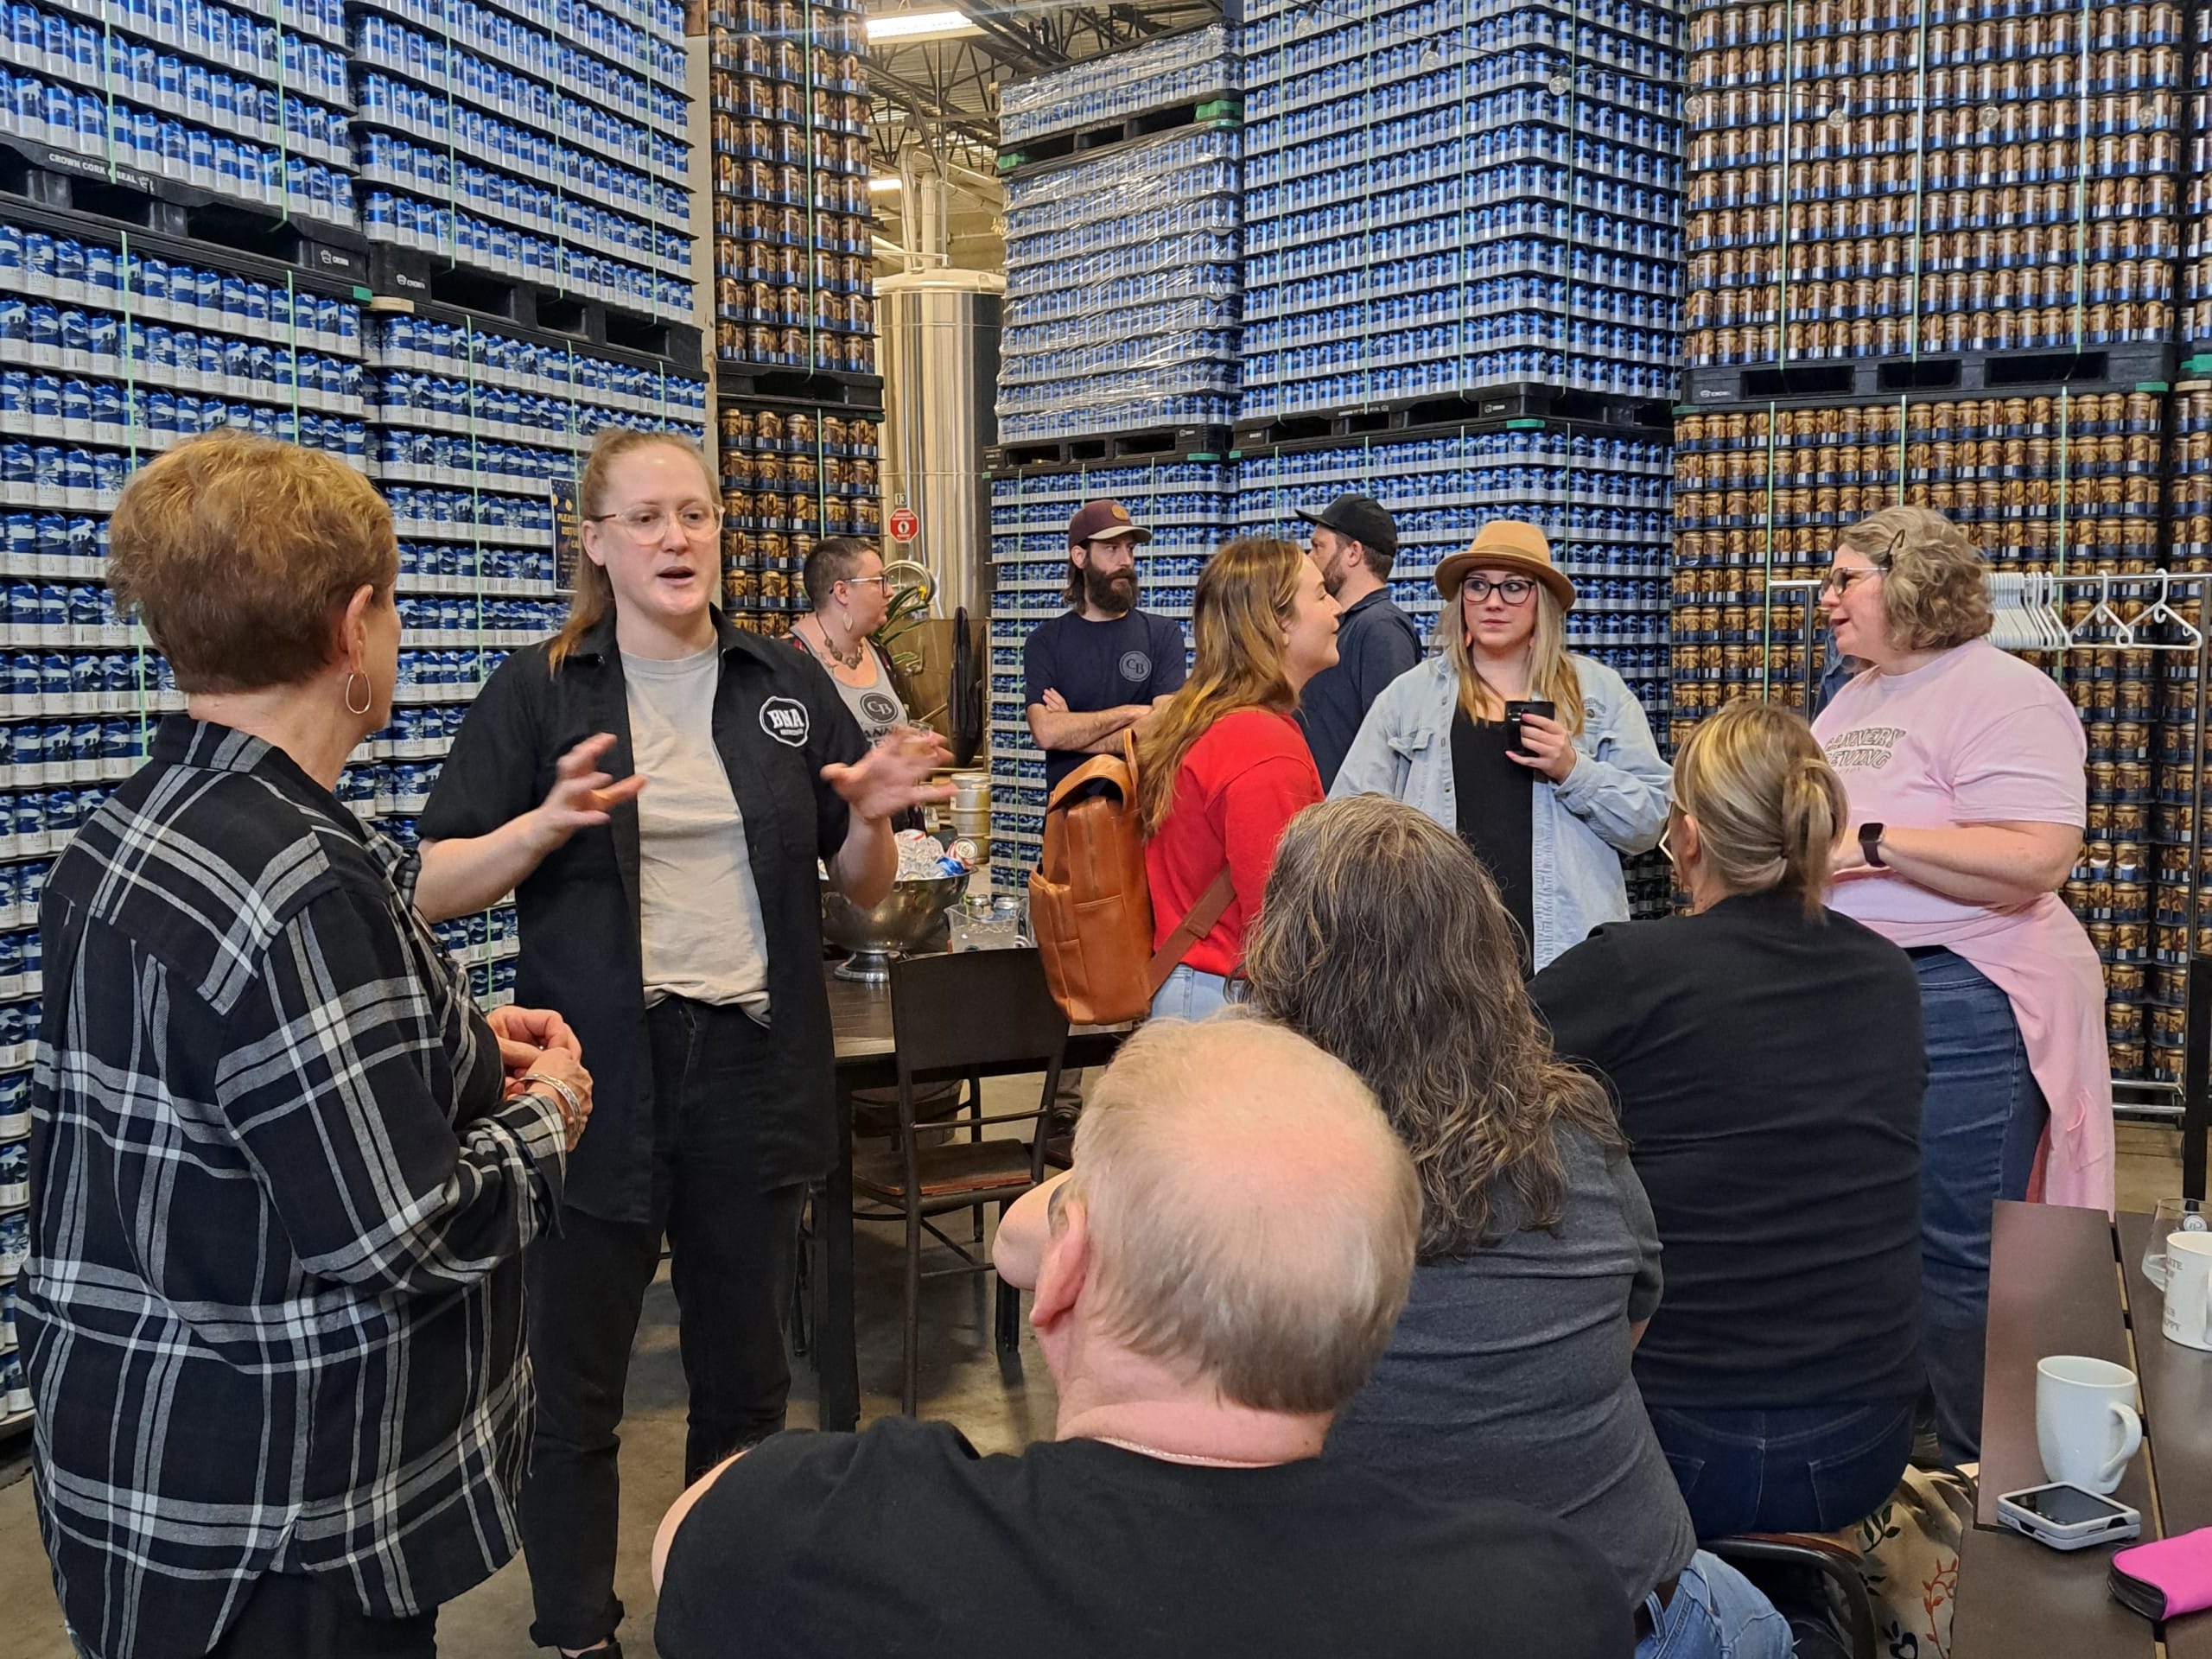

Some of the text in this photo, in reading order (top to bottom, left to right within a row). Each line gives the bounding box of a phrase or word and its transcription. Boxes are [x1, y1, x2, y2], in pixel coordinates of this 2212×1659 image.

[48, 153, 80, 169] CROWN
[82, 162, 106, 175] CORK
[117, 171, 137, 184] SEAL
[896, 494, 906, 504] 13
[1126, 658, 1145, 674] CB
[866, 701, 893, 715] CB
[767, 709, 804, 728] BNA
